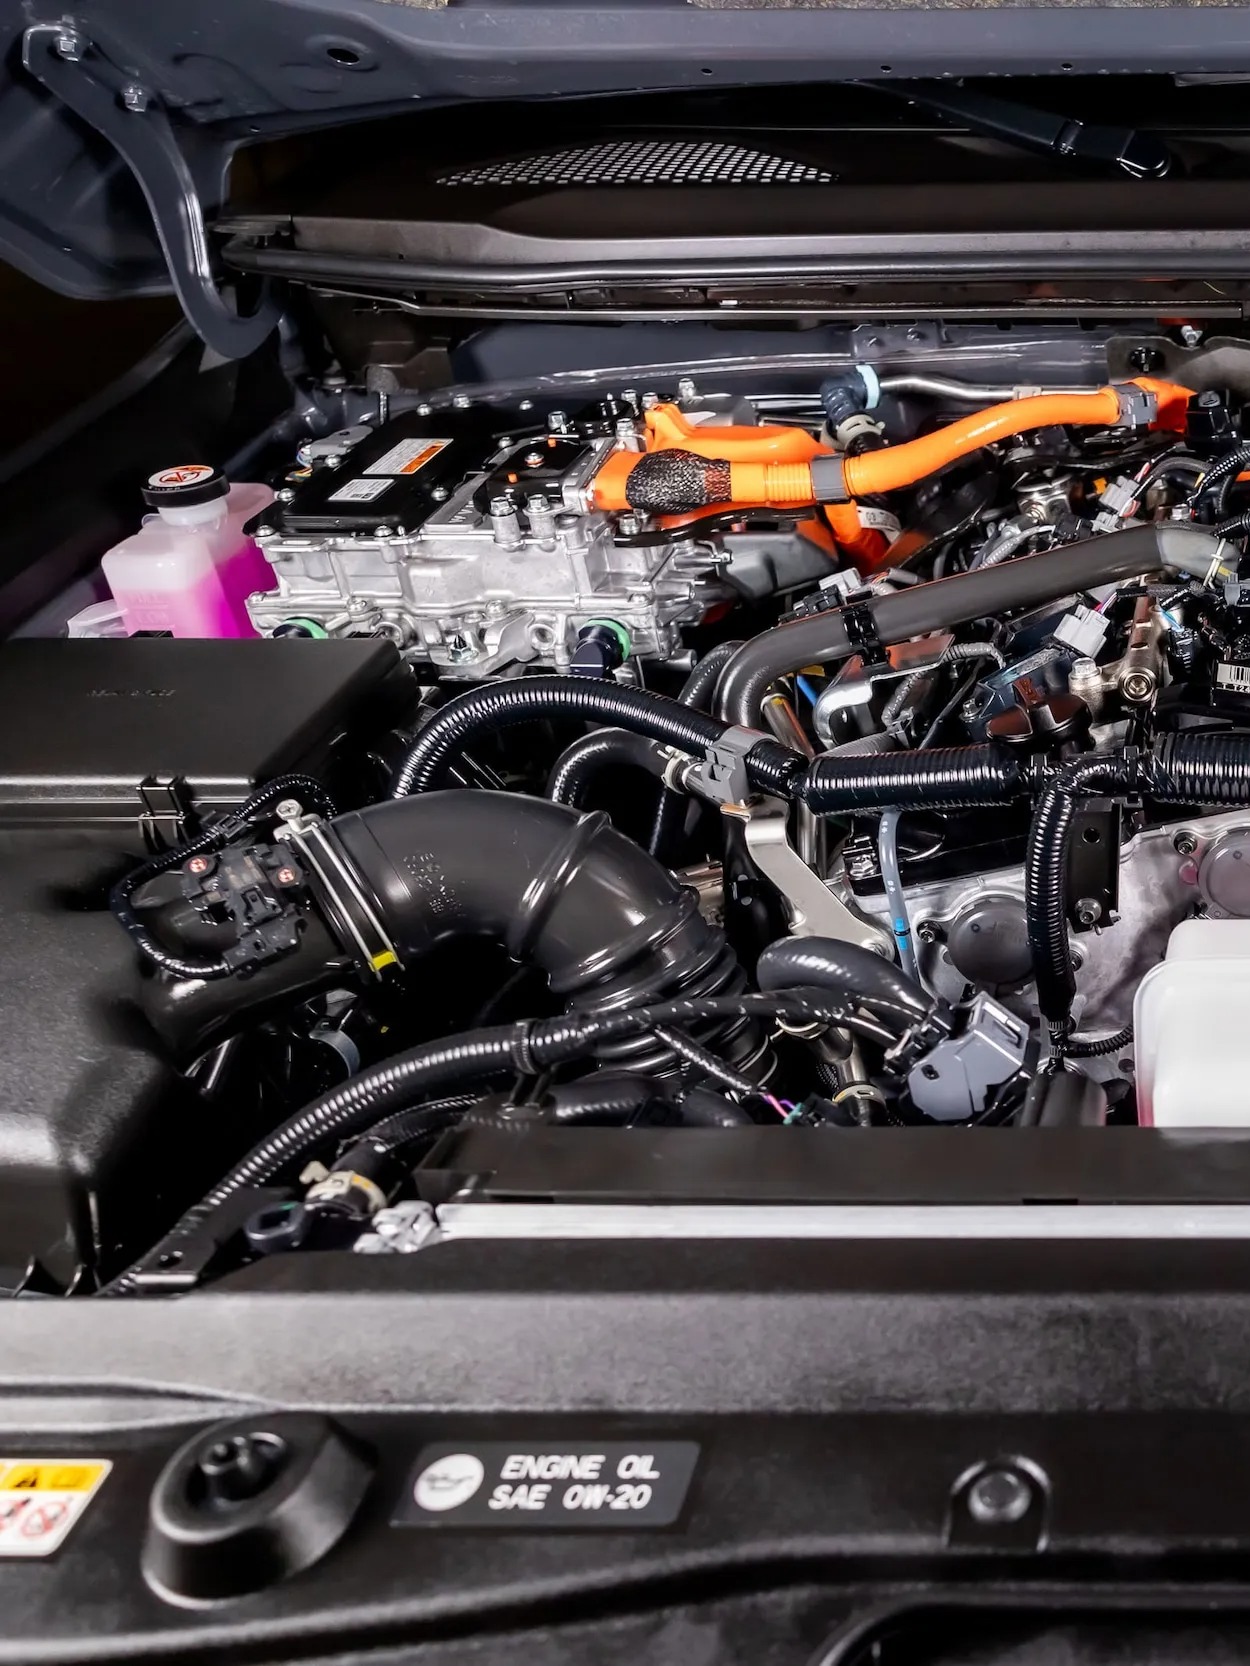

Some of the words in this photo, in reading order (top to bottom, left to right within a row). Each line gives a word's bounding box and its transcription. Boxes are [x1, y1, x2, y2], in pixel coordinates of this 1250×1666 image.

[500, 1454, 606, 1480] ENGINE
[616, 1454, 660, 1480] OIL
[487, 1483, 552, 1511] SAE
[561, 1483, 653, 1511] 0W-20
